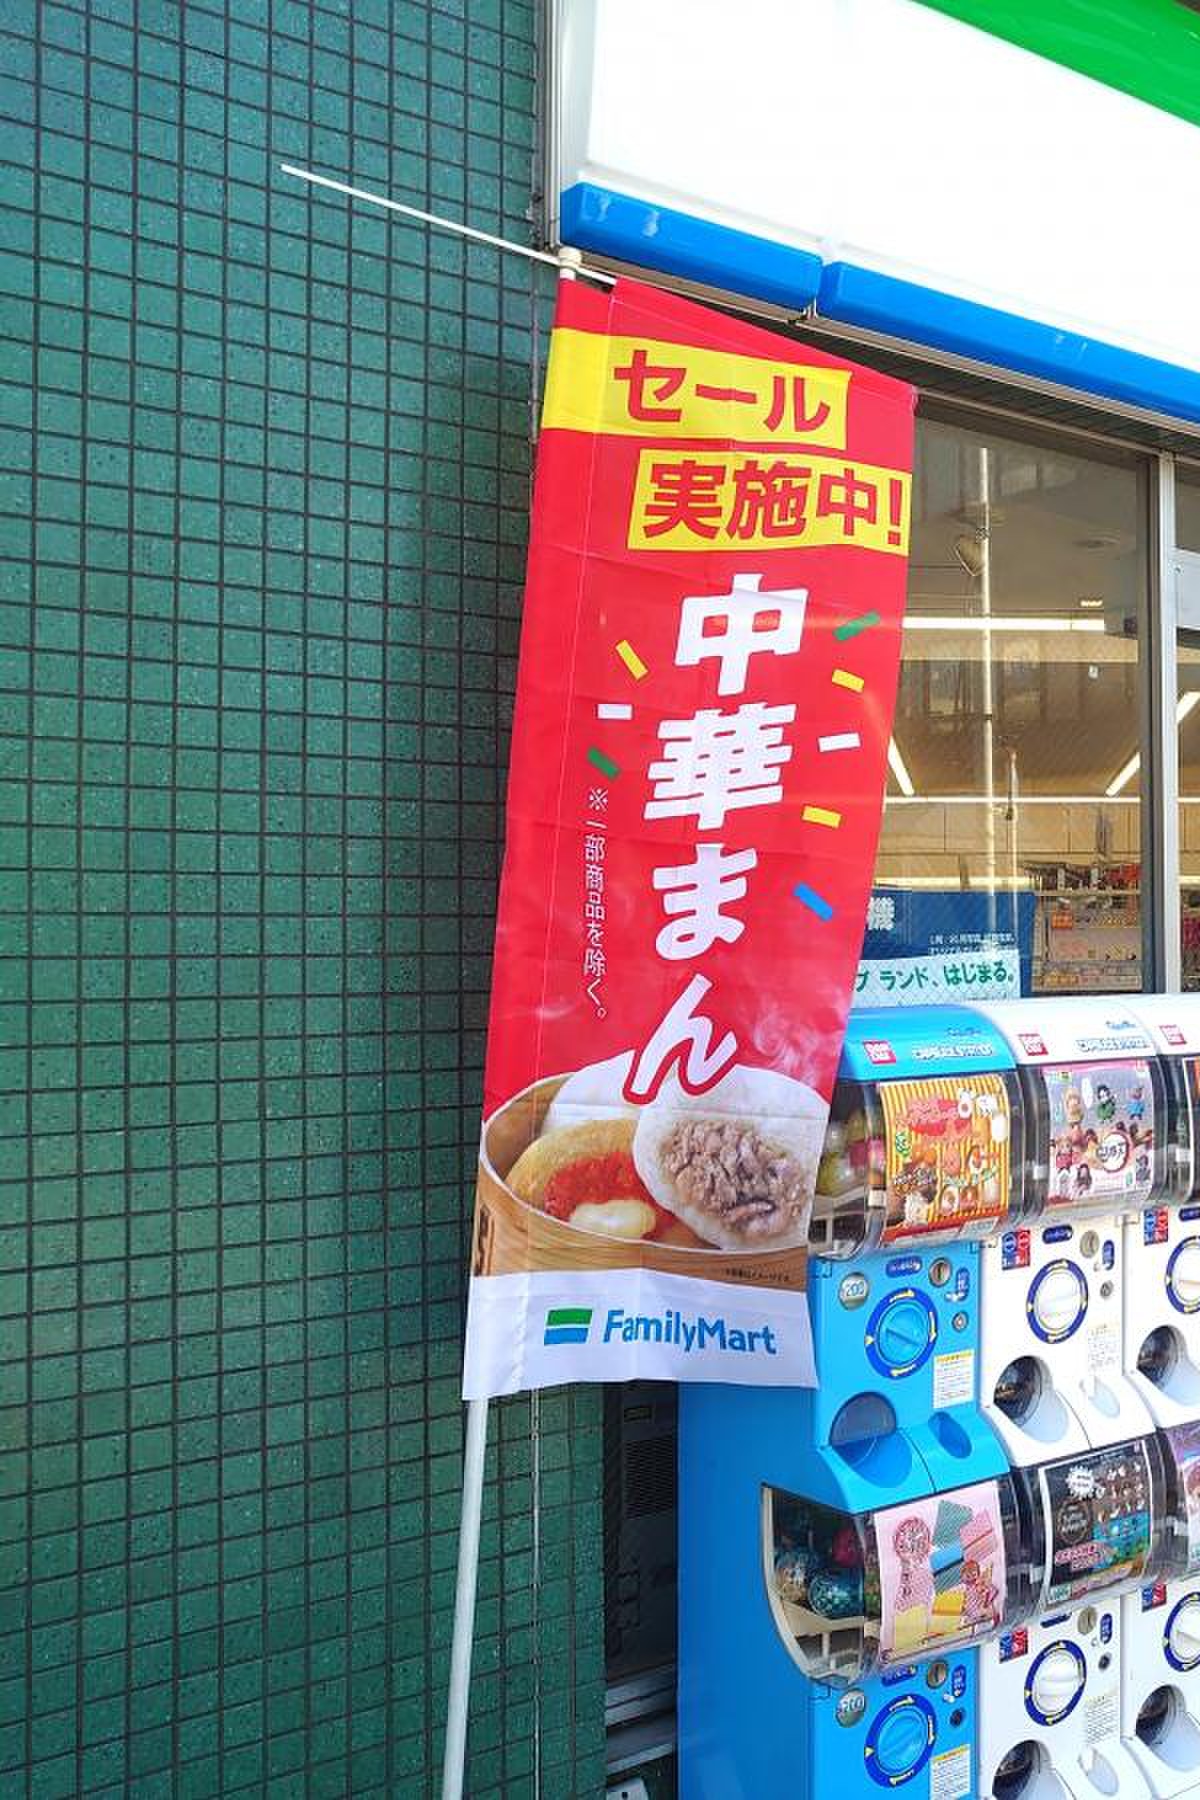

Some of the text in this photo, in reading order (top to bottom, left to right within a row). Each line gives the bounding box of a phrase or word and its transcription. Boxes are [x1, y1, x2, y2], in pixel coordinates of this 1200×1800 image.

[613, 350, 830, 433] セール
[643, 460, 903, 545] 実施中!
[628, 573, 809, 1098] 中華まん
[583, 786, 609, 1019] ※一部商品を除く。
[603, 1309, 776, 1356] FamilyMart
